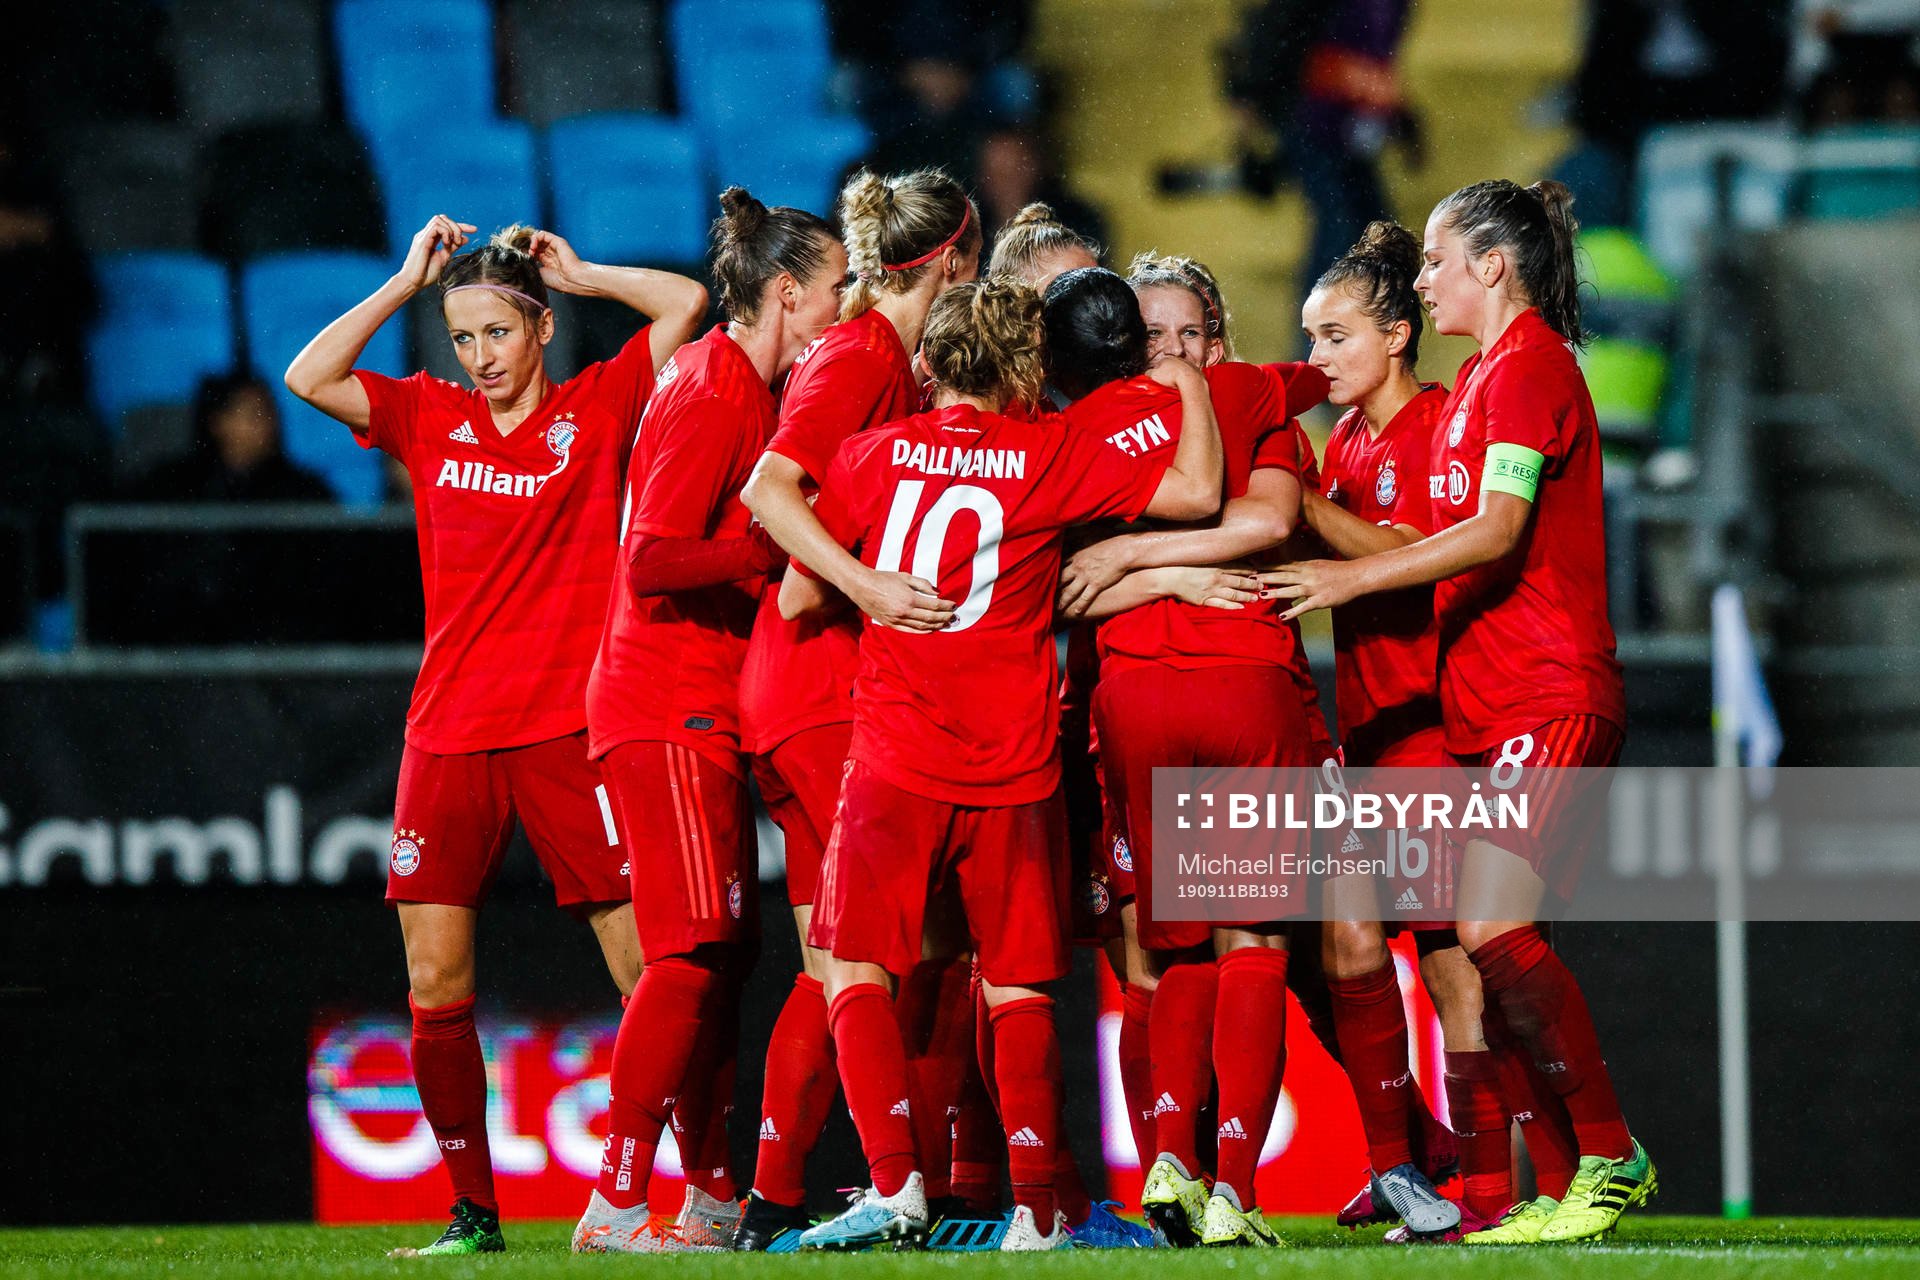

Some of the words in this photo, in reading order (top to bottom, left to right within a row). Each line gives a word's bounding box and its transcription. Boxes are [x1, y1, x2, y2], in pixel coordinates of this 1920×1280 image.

[448, 432, 479, 446] adidas
[892, 439, 1026, 479] DALLMANN
[872, 479, 1004, 633] 10
[1490, 733, 1534, 790] 8
[438, 1138, 467, 1150] FCB
[1008, 1138, 1045, 1147] adidas
